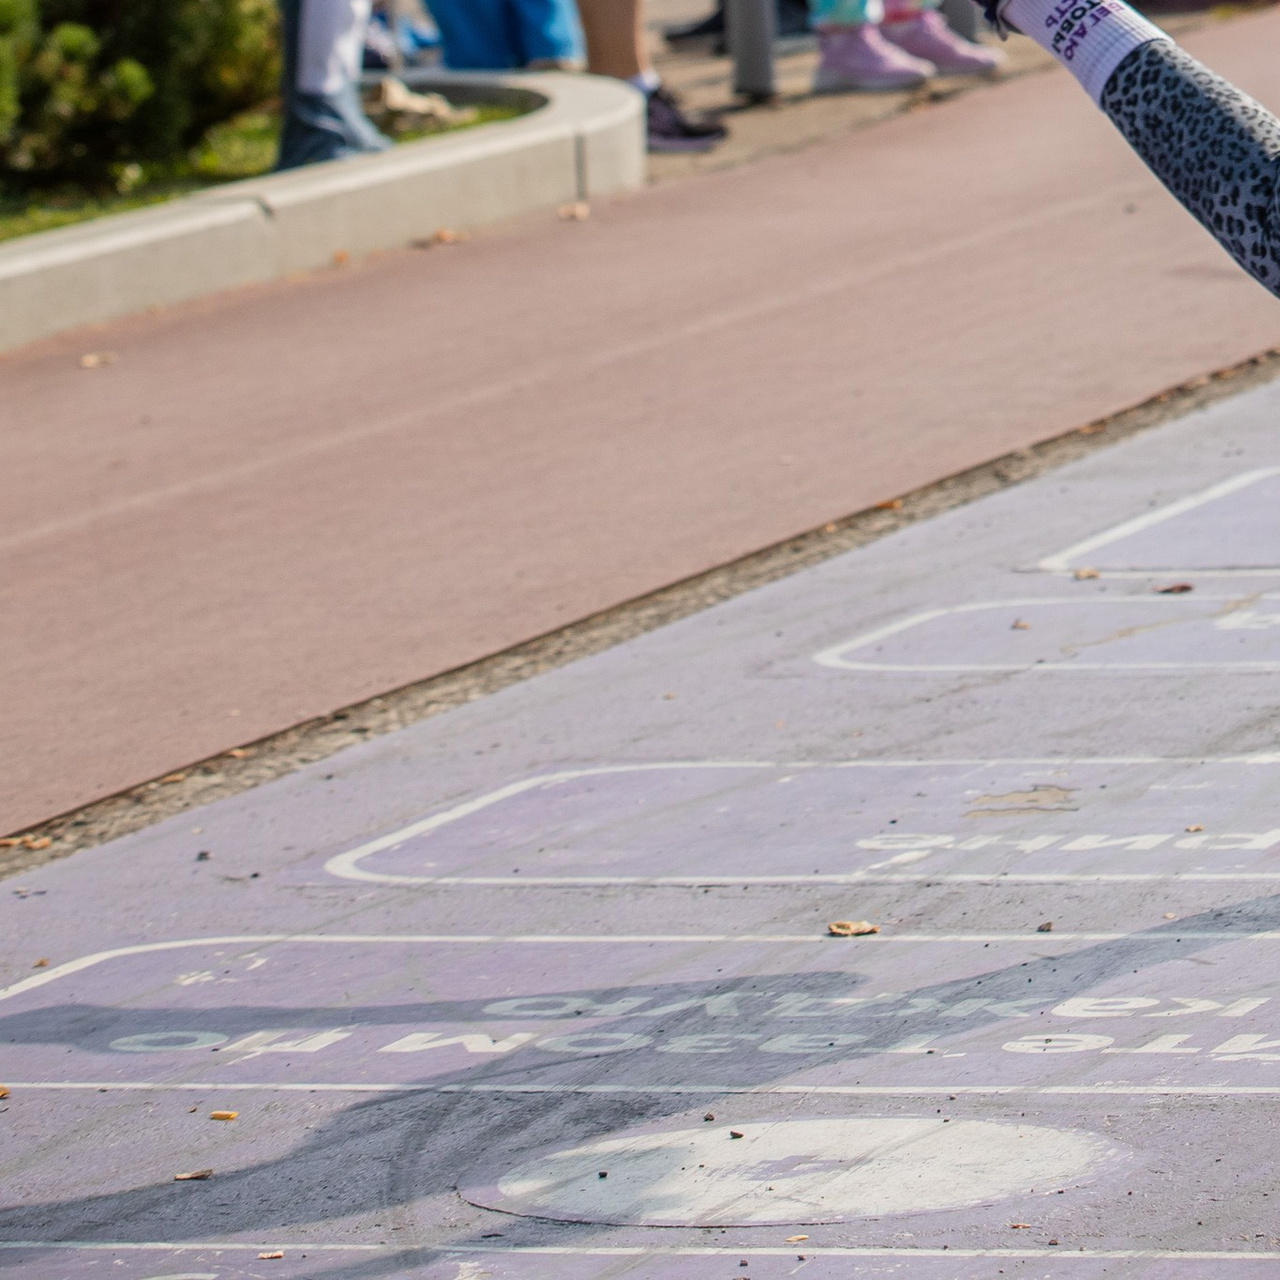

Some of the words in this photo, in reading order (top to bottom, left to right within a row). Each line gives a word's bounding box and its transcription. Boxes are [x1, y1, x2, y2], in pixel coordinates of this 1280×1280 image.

[480, 991, 1272, 1018] каждую
[108, 1027, 352, 1056] по
[380, 1030, 946, 1055] тазом
